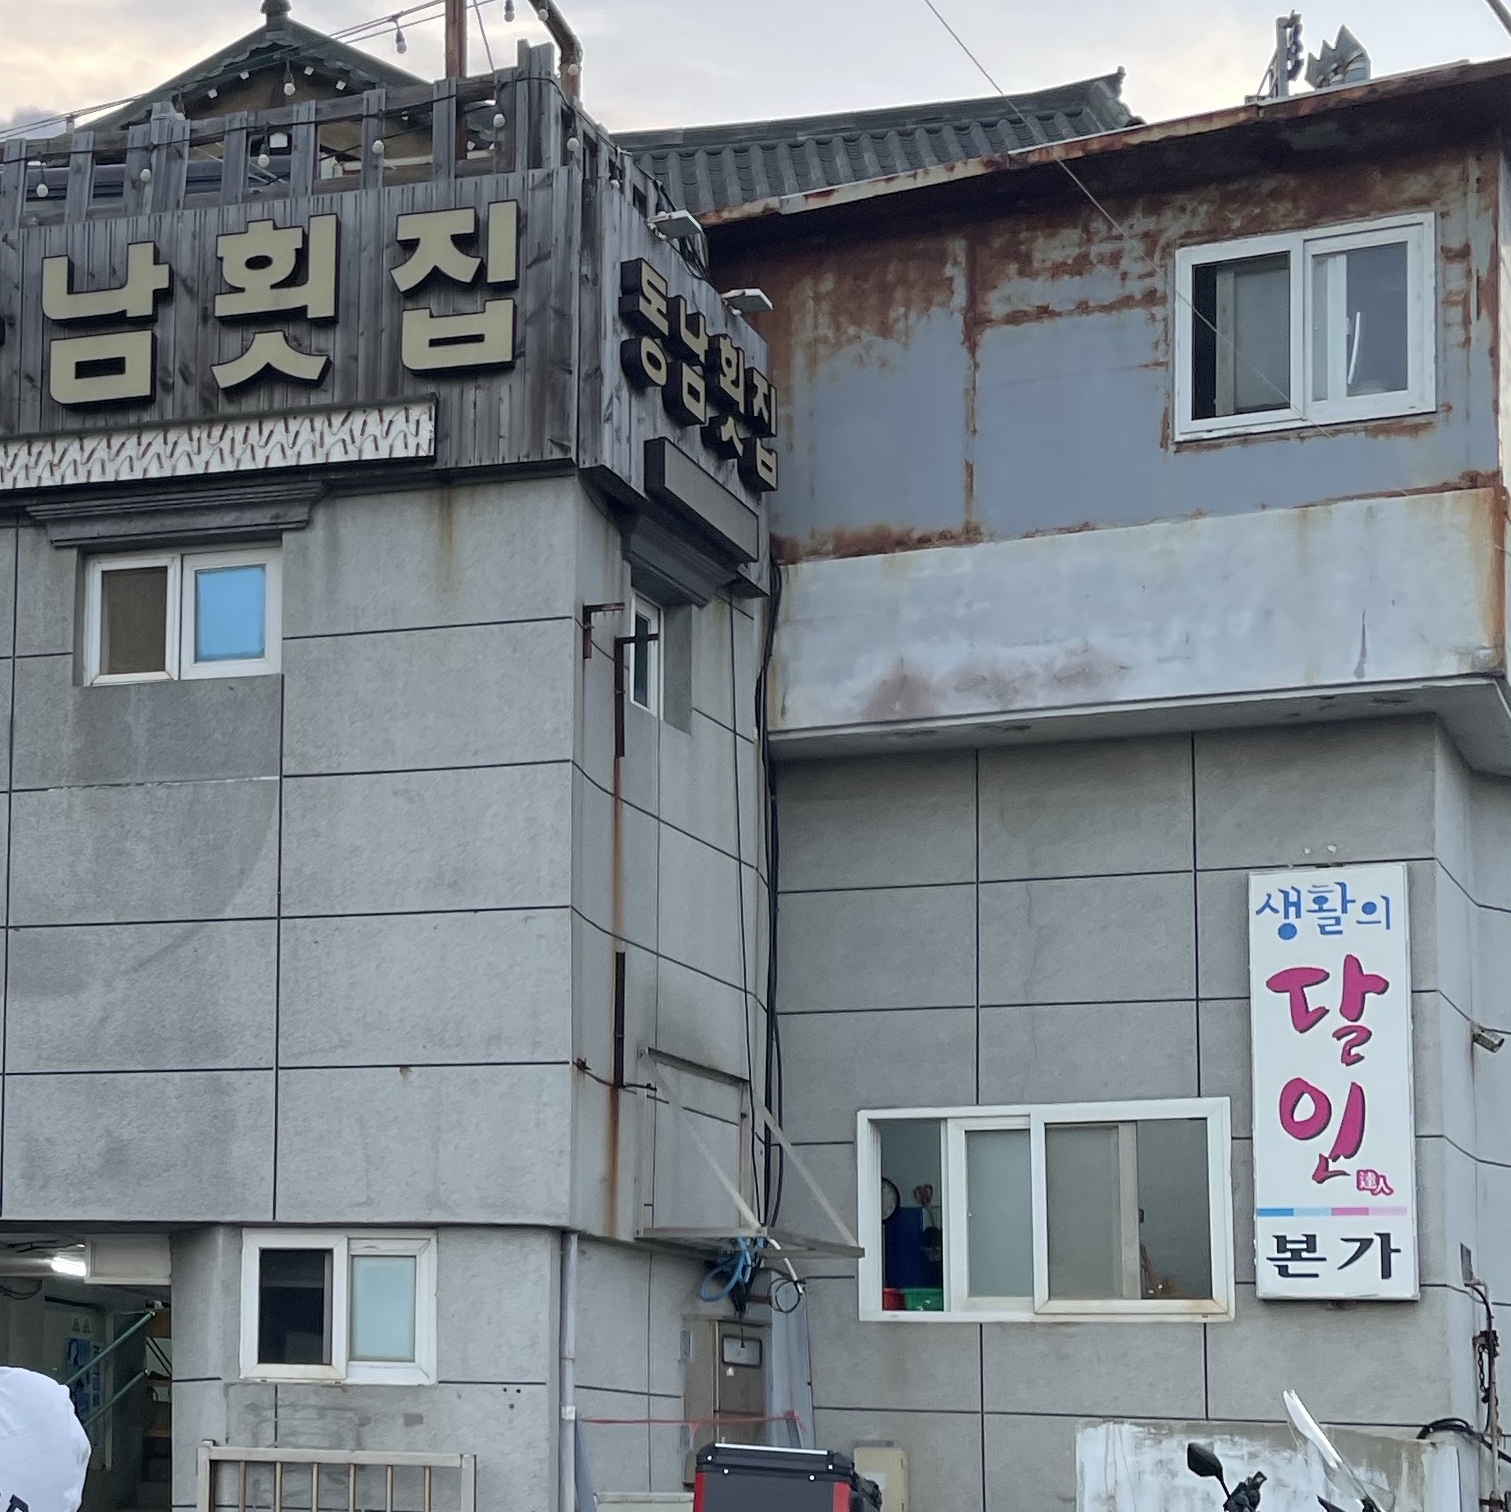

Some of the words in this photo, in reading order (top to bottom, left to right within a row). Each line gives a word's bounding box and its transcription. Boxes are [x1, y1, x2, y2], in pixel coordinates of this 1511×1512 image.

[623, 258, 779, 491] 동남횟집
[1255, 881, 1392, 940] 생활의
[1265, 1231, 1402, 1281] 본가
